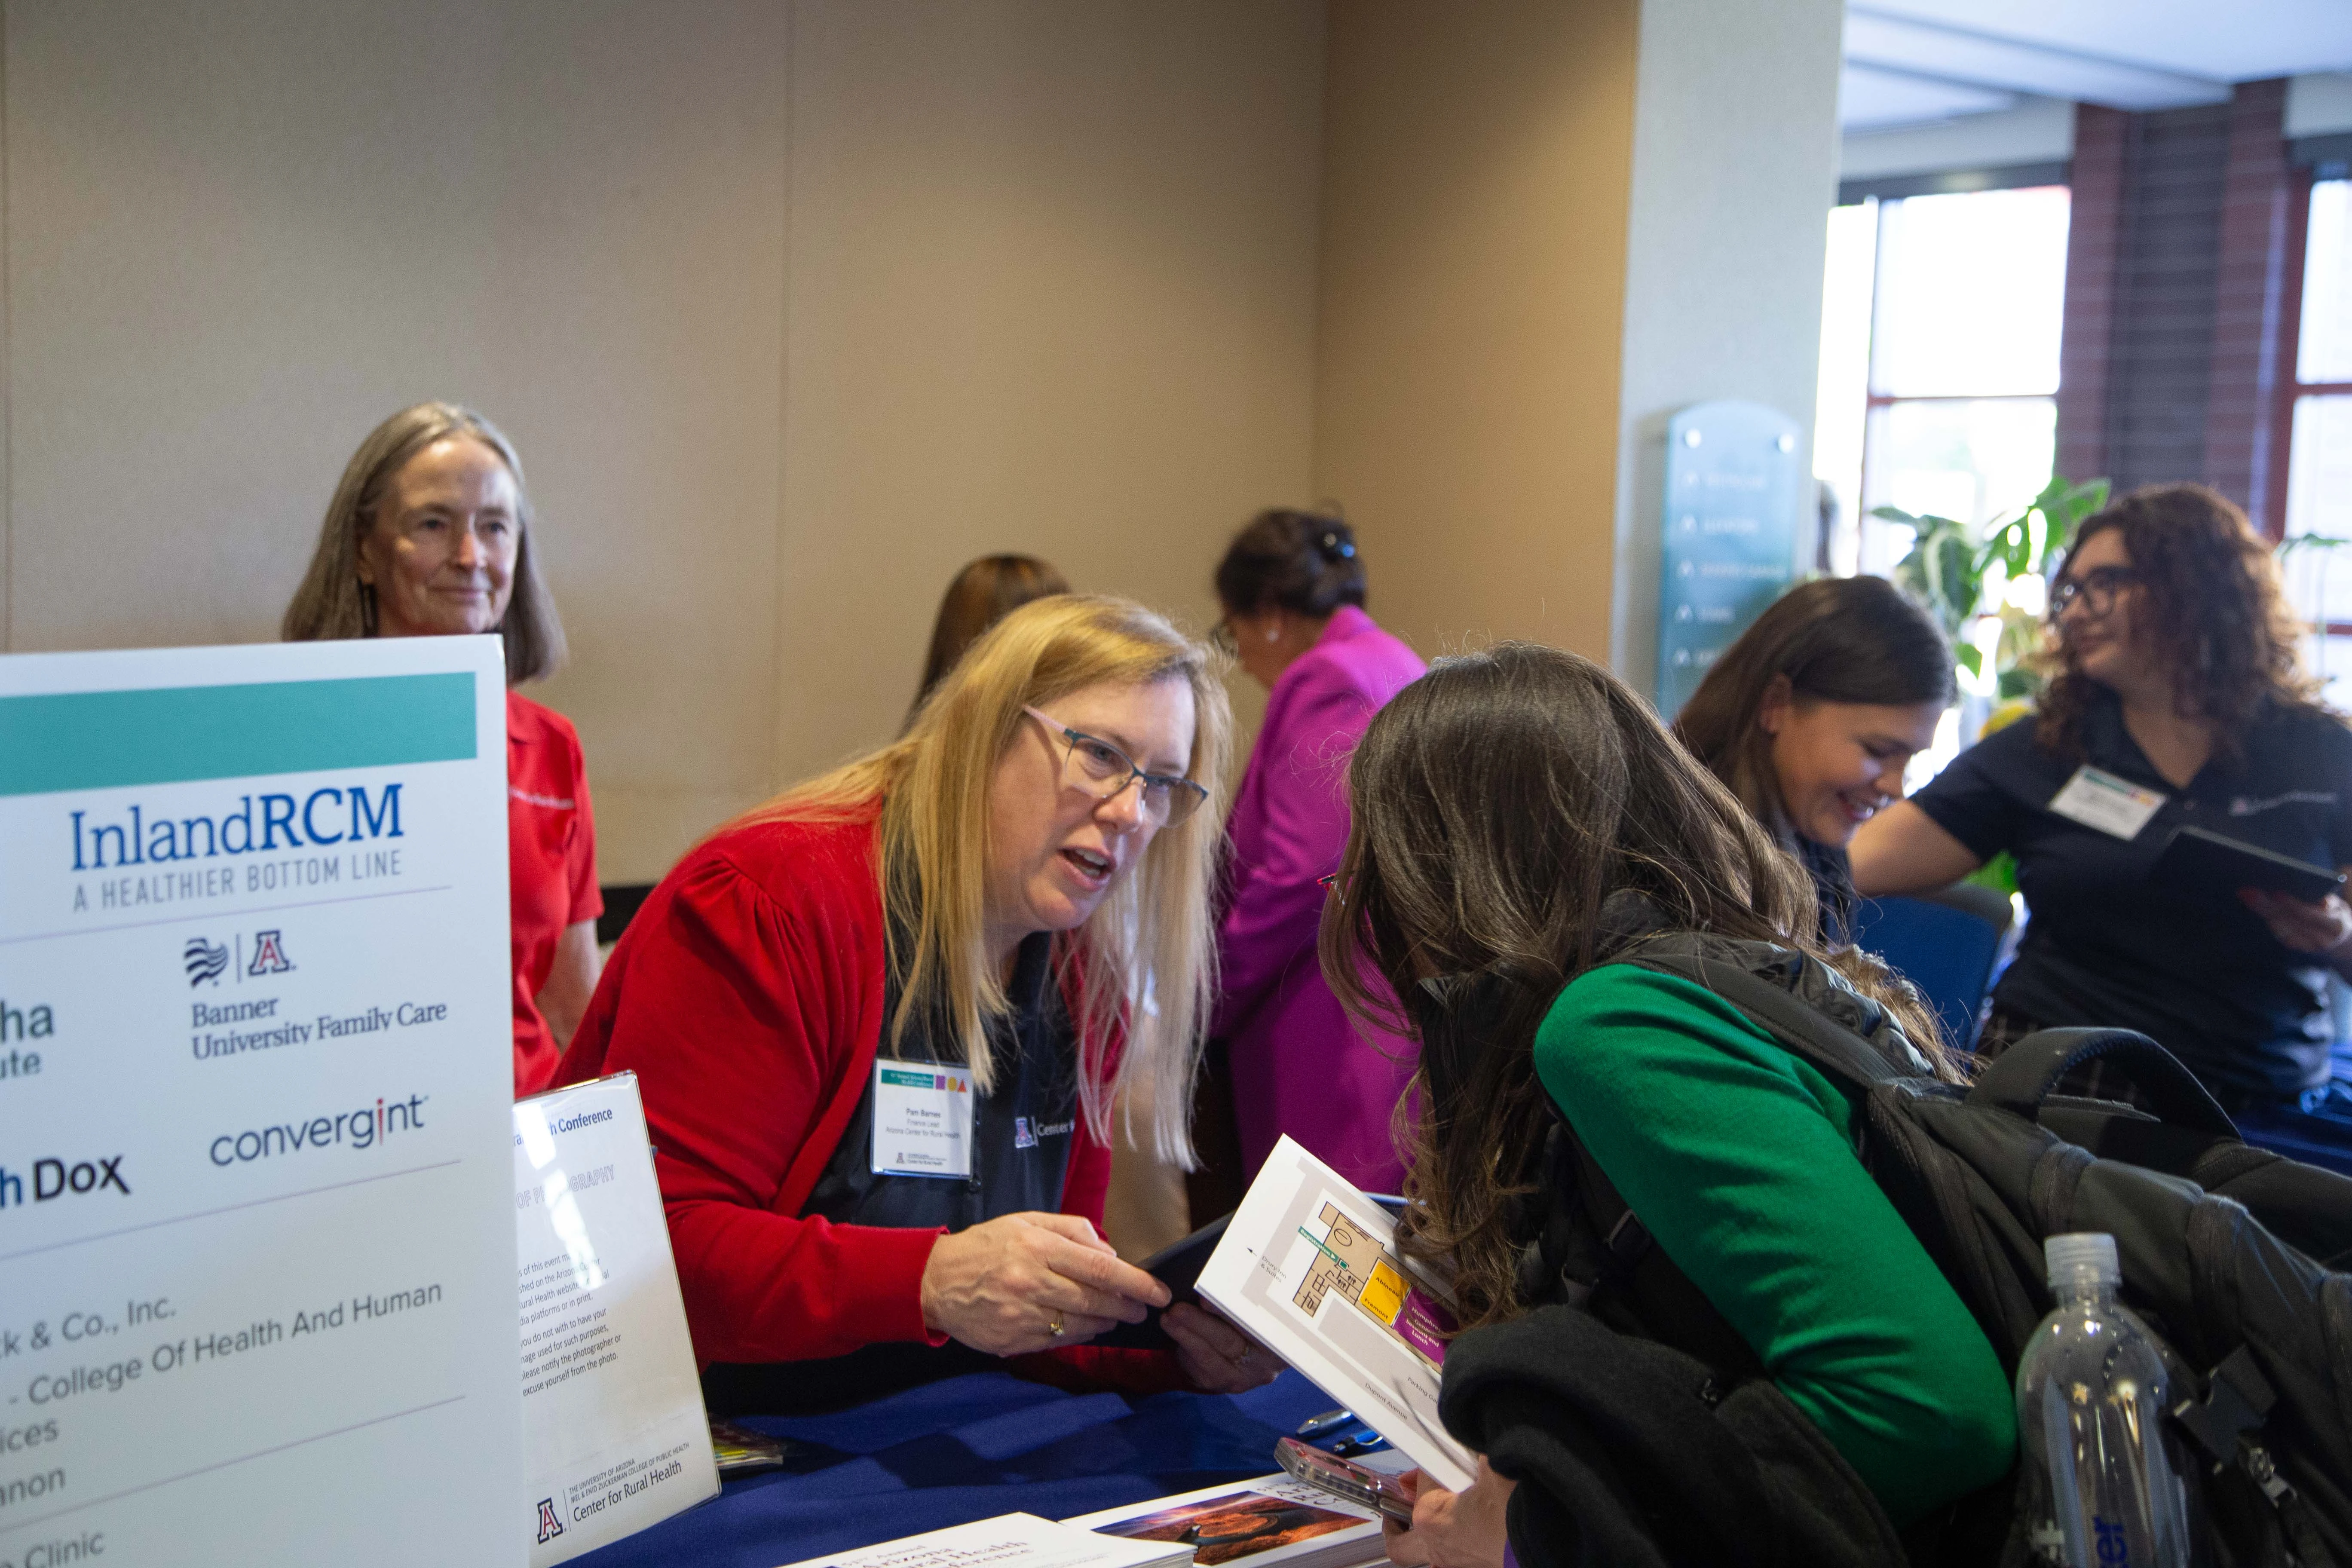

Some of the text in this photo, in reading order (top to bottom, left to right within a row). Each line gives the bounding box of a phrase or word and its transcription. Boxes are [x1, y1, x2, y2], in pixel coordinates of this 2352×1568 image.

[69, 783, 404, 871] InlandRCM
[74, 849, 402, 913] A HEALTHIER BOTTOM LINE
[191, 998, 279, 1029] Banner
[191, 1002, 447, 1060] University Family Care
[209, 1094, 425, 1167] convergint
[559, 1108, 612, 1133] Conference
[516, 1189, 531, 1209] OF
[1300, 1229, 1330, 1256] Registration
[524, 1265, 530, 1276] of
[531, 1262, 543, 1273] this
[544, 1255, 560, 1268] event
[1265, 1266, 1281, 1283] Suites
[519, 1280, 534, 1293] shed
[536, 1278, 544, 1287] on
[545, 1274, 555, 1284] the
[535, 1289, 555, 1304] Health
[1376, 1277, 1400, 1297] Abineau
[31, 1321, 51, 1350] &
[62, 1311, 119, 1341] Co.,
[128, 1297, 176, 1327] Inc.
[520, 1292, 593, 1326] dia platforms or in print.
[533, 1333, 541, 1343] do
[543, 1329, 554, 1340] not
[554, 1321, 569, 1334] with
[570, 1320, 576, 1329] to
[577, 1315, 592, 1326] have
[593, 1308, 606, 1321] your
[1365, 1298, 1388, 1319] Fremont
[28, 1359, 142, 1405] College
[152, 1340, 186, 1372] Of
[194, 1319, 282, 1363] Health
[292, 1302, 343, 1338] And
[352, 1283, 442, 1322] Human
[537, 1344, 552, 1357] used
[554, 1340, 563, 1351] for
[564, 1335, 579, 1348] such
[579, 1324, 609, 1343] purposes,
[542, 1358, 559, 1373] notify
[561, 1354, 572, 1365] the
[573, 1337, 613, 1361] photographer
[615, 1334, 622, 1343] or
[1412, 1330, 1428, 1346] Lunch
[1429, 1336, 1439, 1348] and
[523, 1352, 619, 1397] excuse yourself from the photo.
[1408, 1377, 1427, 1396] Parking
[1365, 1383, 1407, 1420] Dupont Avenue
[569, 1485, 579, 1495] THE
[579, 1473, 607, 1490] UNIVERSITY
[616, 1458, 635, 1473] ARIZONA
[571, 1494, 581, 1504] MEL
[586, 1485, 597, 1497] ENID
[599, 1472, 628, 1491] ZUCKERMAN
[628, 1462, 648, 1479] COLLEGE
[656, 1451, 672, 1463] PUBLIC
[673, 1442, 690, 1455] HEALTH
[573, 1460, 682, 1522] Center for Rural Health
[25, 1531, 104, 1568] Clinic
